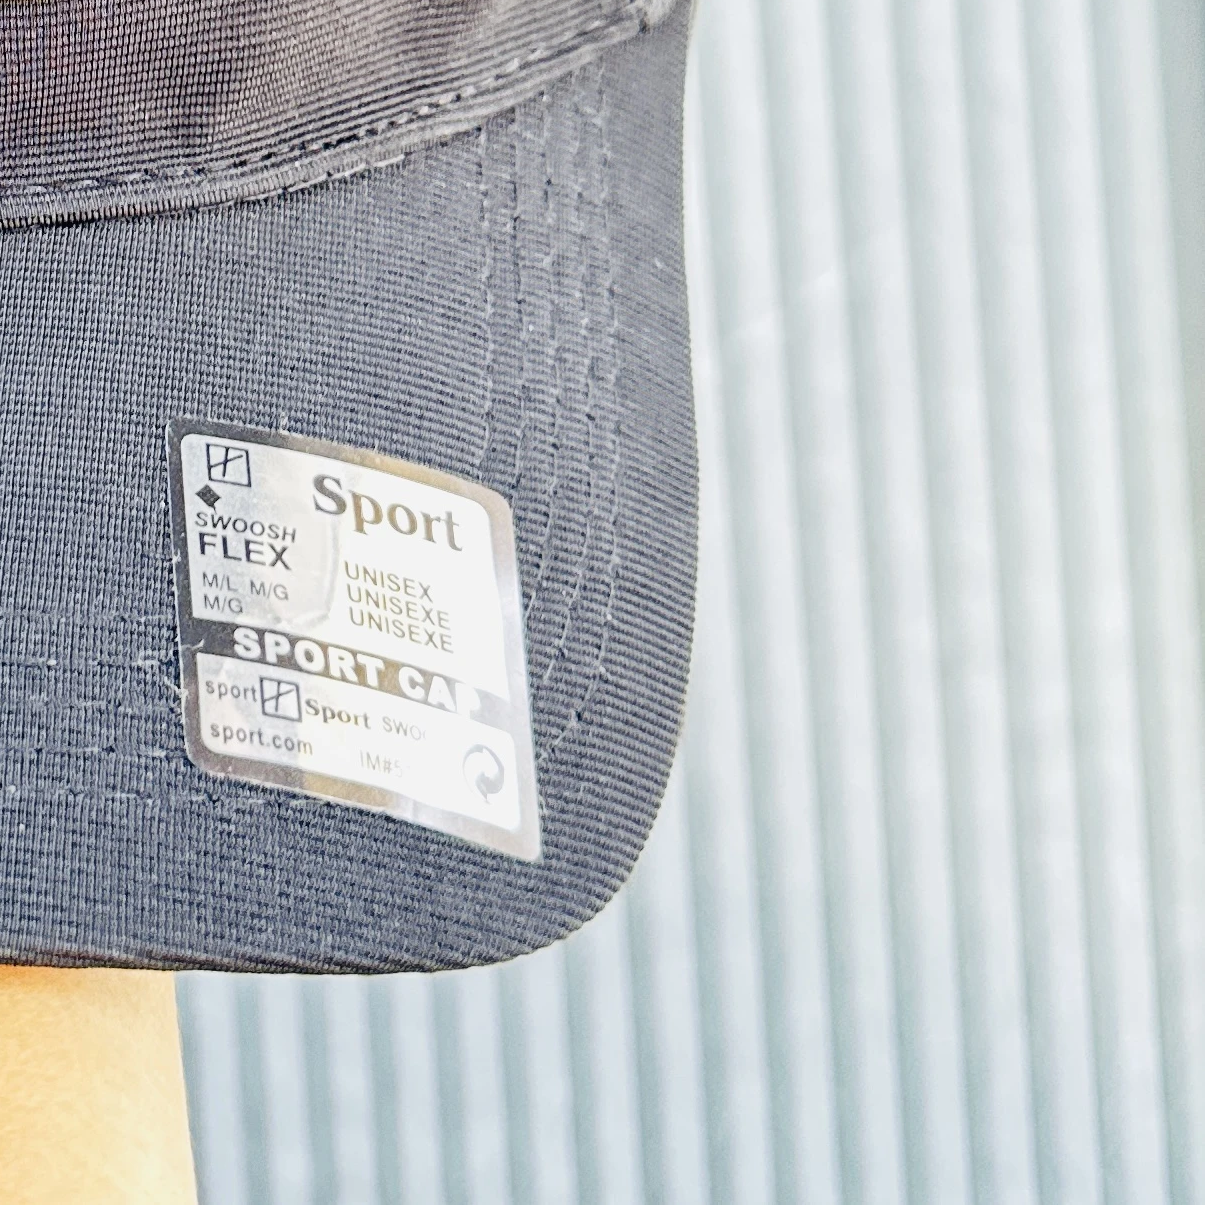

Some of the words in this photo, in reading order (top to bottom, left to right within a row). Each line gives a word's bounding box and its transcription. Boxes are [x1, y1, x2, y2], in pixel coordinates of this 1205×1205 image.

[195, 512, 297, 543] SWOOSH
[312, 474, 463, 551] Sport
[199, 532, 292, 571] FLEX
[202, 571, 239, 592] M/L
[250, 579, 289, 601] M/G
[344, 560, 433, 603] UNISEX
[204, 593, 244, 614] M/G
[347, 583, 451, 631] UNISEXE
[349, 606, 454, 654] UNISEXE
[233, 626, 386, 690] SPORT
[205, 680, 258, 703] sport
[305, 698, 371, 730] Sport
[382, 716, 426, 741] SWO
[210, 722, 313, 755] sport.com
